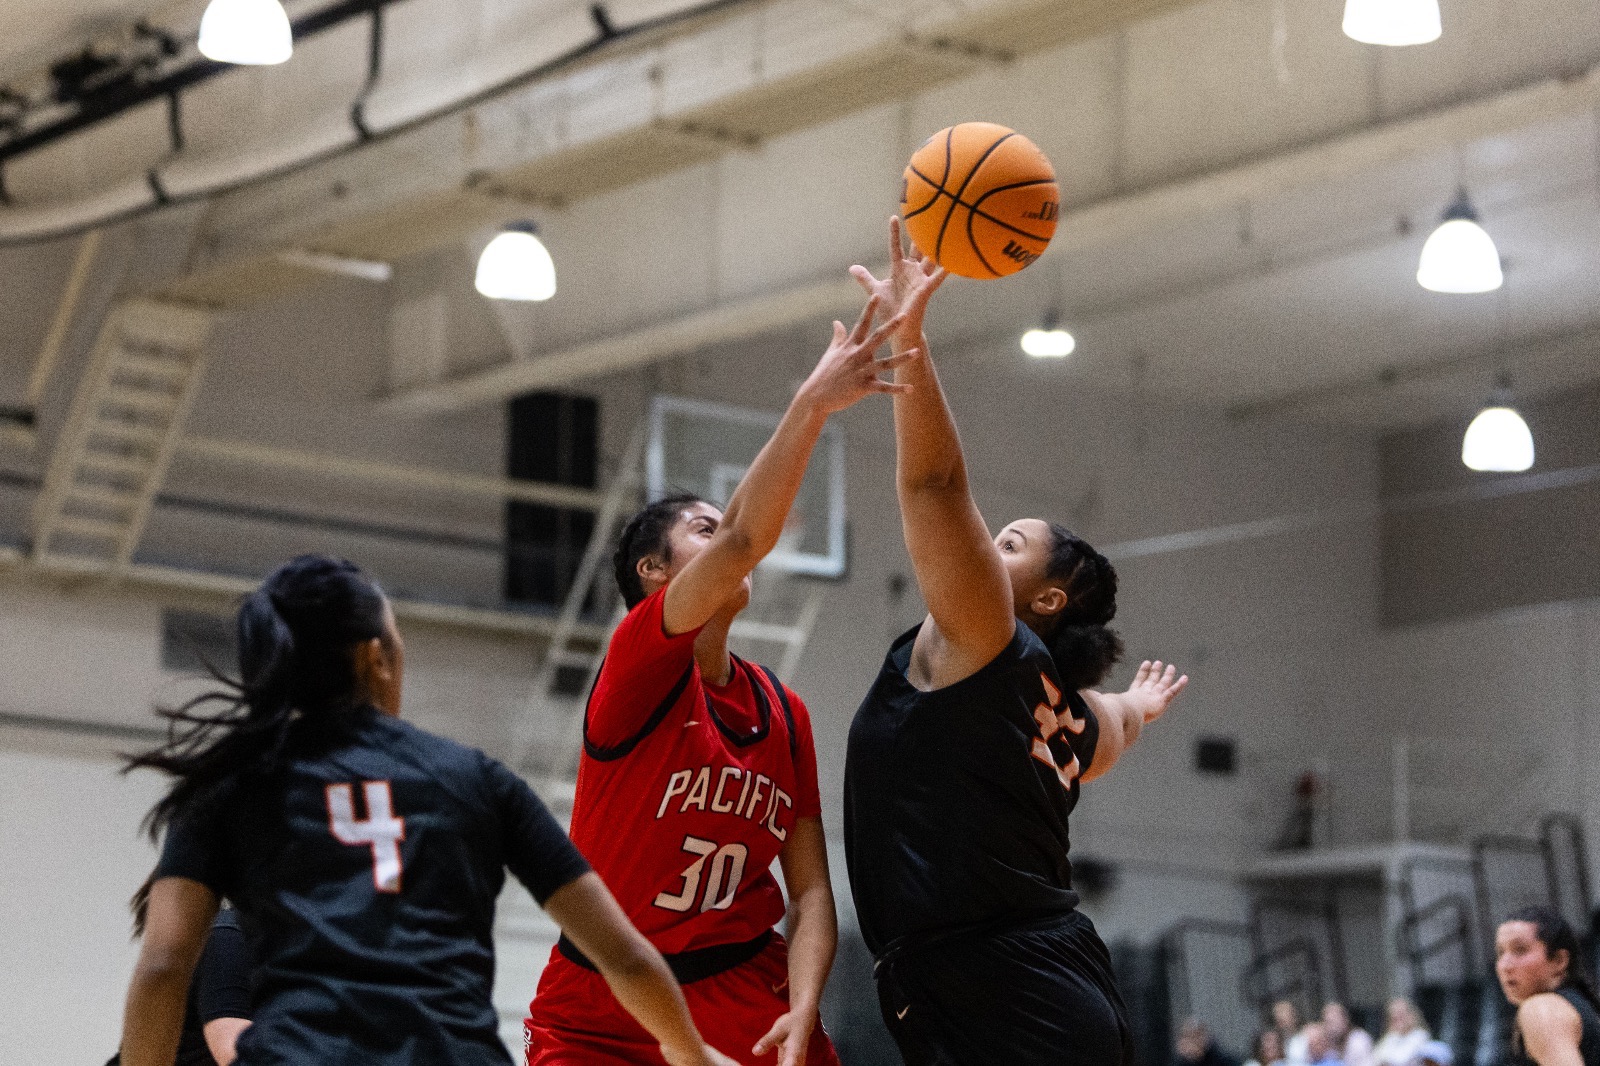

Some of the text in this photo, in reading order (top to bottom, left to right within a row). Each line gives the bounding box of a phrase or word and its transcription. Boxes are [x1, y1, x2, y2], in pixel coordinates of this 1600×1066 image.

[324, 779, 406, 894] 4
[655, 765, 793, 842] PACIFIC
[653, 834, 748, 914] 30
